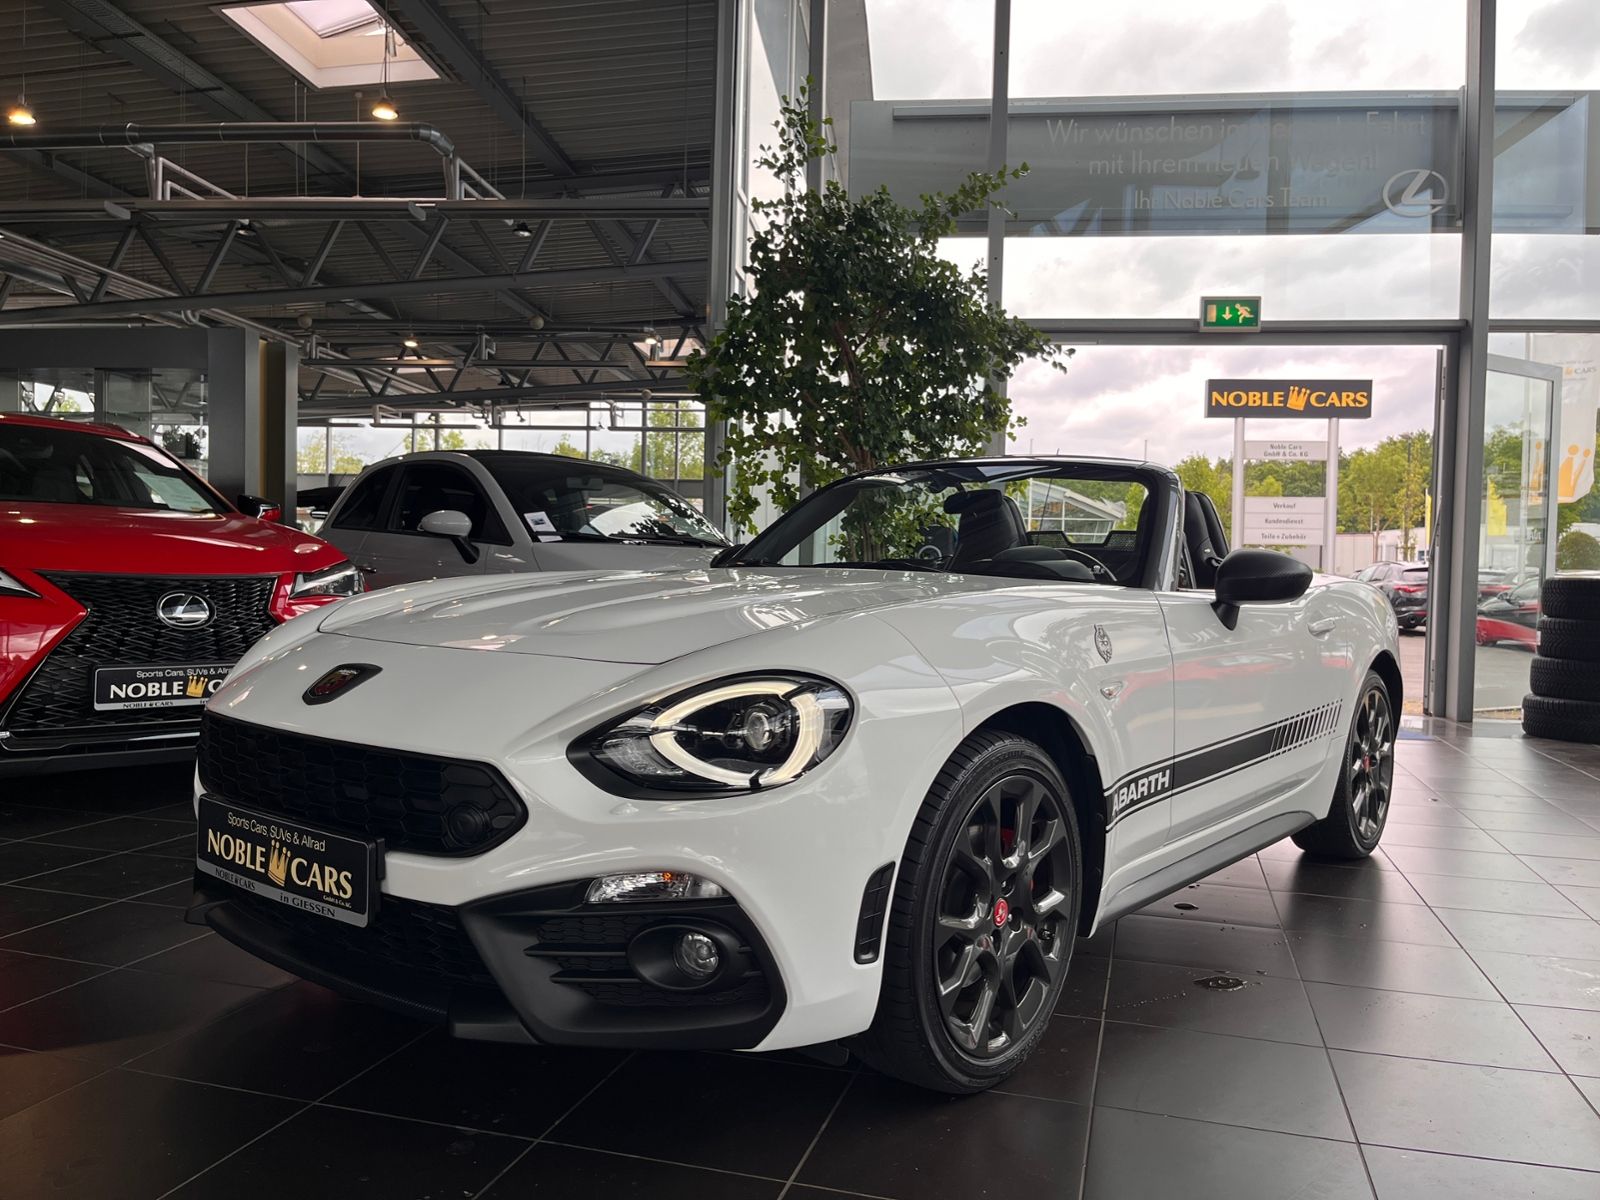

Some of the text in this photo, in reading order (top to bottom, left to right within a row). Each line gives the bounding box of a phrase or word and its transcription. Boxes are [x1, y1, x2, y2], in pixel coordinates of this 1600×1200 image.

[1046, 119, 1088, 143] Wir
[1095, 116, 1213, 143] wünschen
[1088, 154, 1124, 175] mit
[1132, 150, 1199, 175] Ihrem
[1165, 189, 1223, 209] Noble
[1229, 189, 1275, 208] Cars
[1211, 391, 1368, 408] NOBLE CARS
[136, 670, 163, 679] Sports
[187, 668, 208, 676] SUVs
[209, 667, 215, 675] &
[110, 681, 184, 699] NOBLE
[1112, 769, 1170, 817] ABARTH
[227, 812, 250, 831] Sports
[270, 825, 292, 844] SUVs
[292, 832, 300, 845] &
[301, 836, 326, 852] Allrad
[207, 828, 353, 899] NOBLE CARS
[215, 867, 234, 882] NOBLE
[239, 879, 256, 892] CARS
[292, 895, 336, 918] GIESSEN
